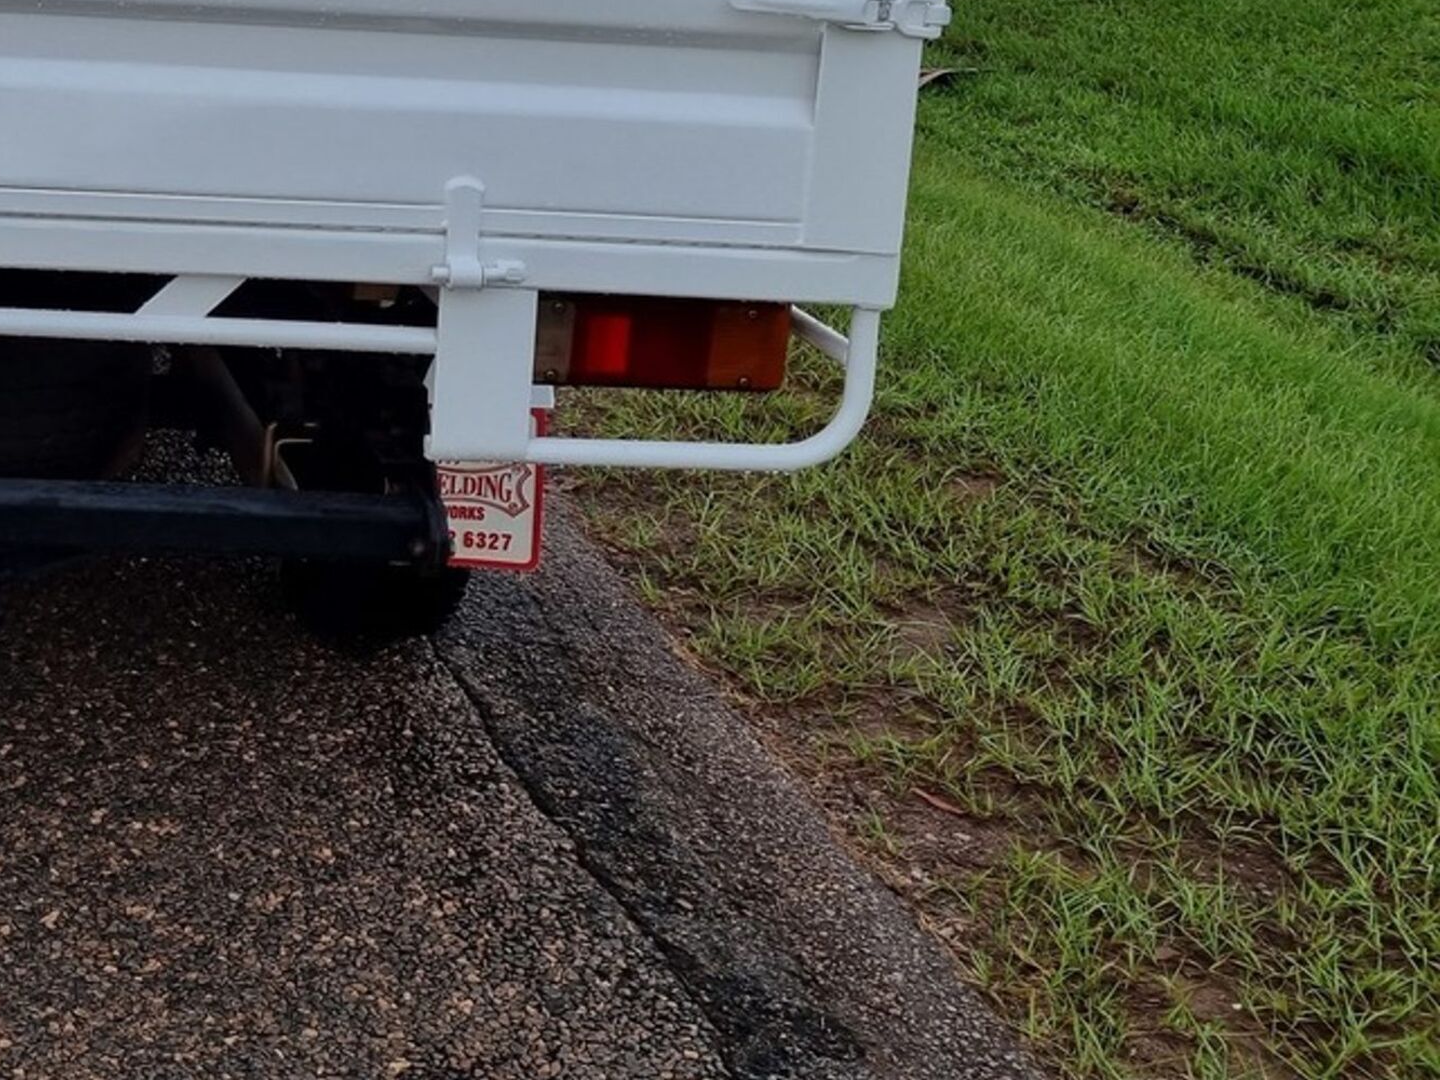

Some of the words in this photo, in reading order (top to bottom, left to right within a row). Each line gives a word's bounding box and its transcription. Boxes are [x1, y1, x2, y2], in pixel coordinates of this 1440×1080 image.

[436, 472, 513, 503] ELDING
[447, 505, 486, 521] ORKS
[463, 531, 512, 551] 6327
